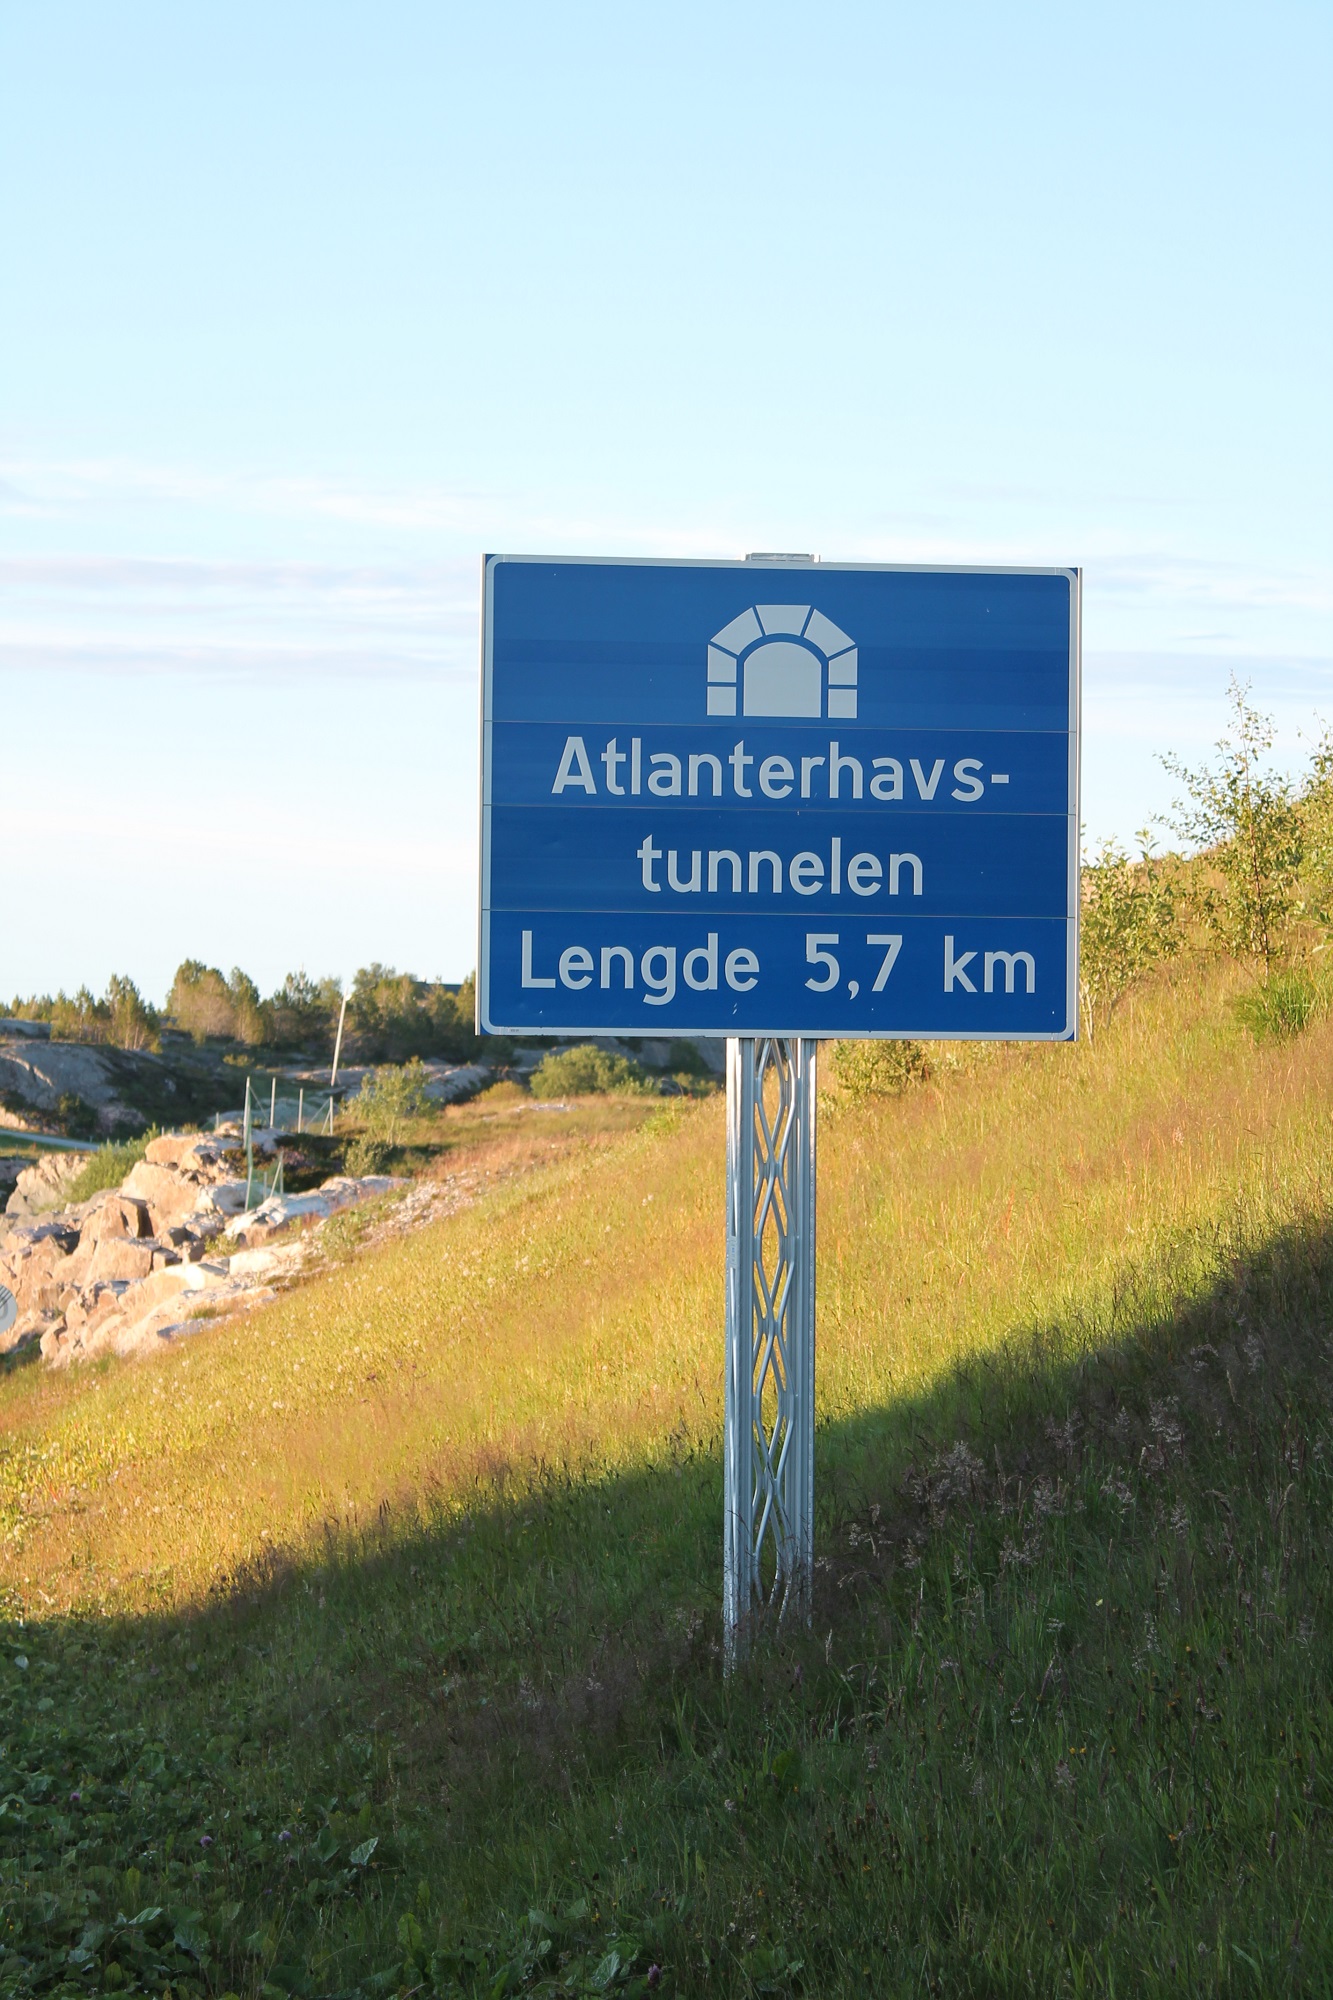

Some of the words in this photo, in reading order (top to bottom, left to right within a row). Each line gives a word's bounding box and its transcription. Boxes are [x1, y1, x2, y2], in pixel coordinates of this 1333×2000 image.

[551, 736, 1010, 802] Atlanterhavs-
[636, 835, 923, 896] tunnelen
[521, 931, 760, 1006] Lengde
[804, 933, 903, 1000] 5,7
[944, 935, 1035, 994] km
